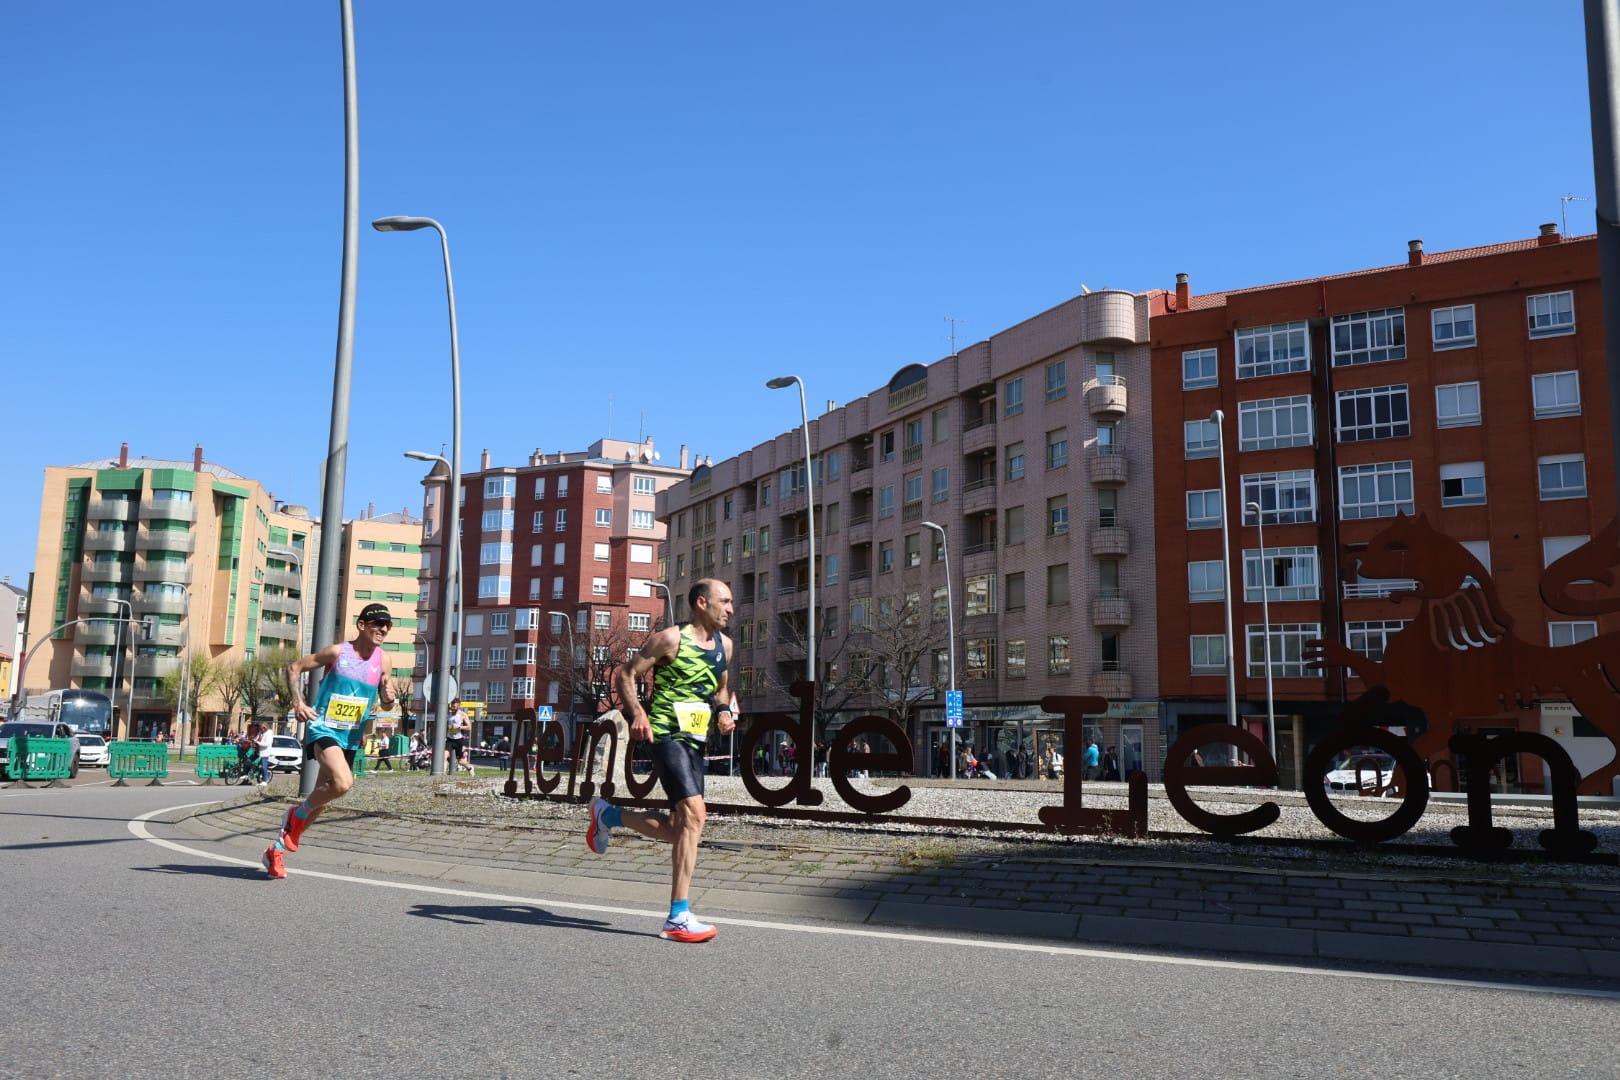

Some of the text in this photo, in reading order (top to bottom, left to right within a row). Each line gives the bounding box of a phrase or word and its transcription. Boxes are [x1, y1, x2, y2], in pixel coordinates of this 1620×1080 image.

[335, 703, 361, 717] 3227
[740, 680, 915, 813] de
[1037, 685, 1599, 853] León
